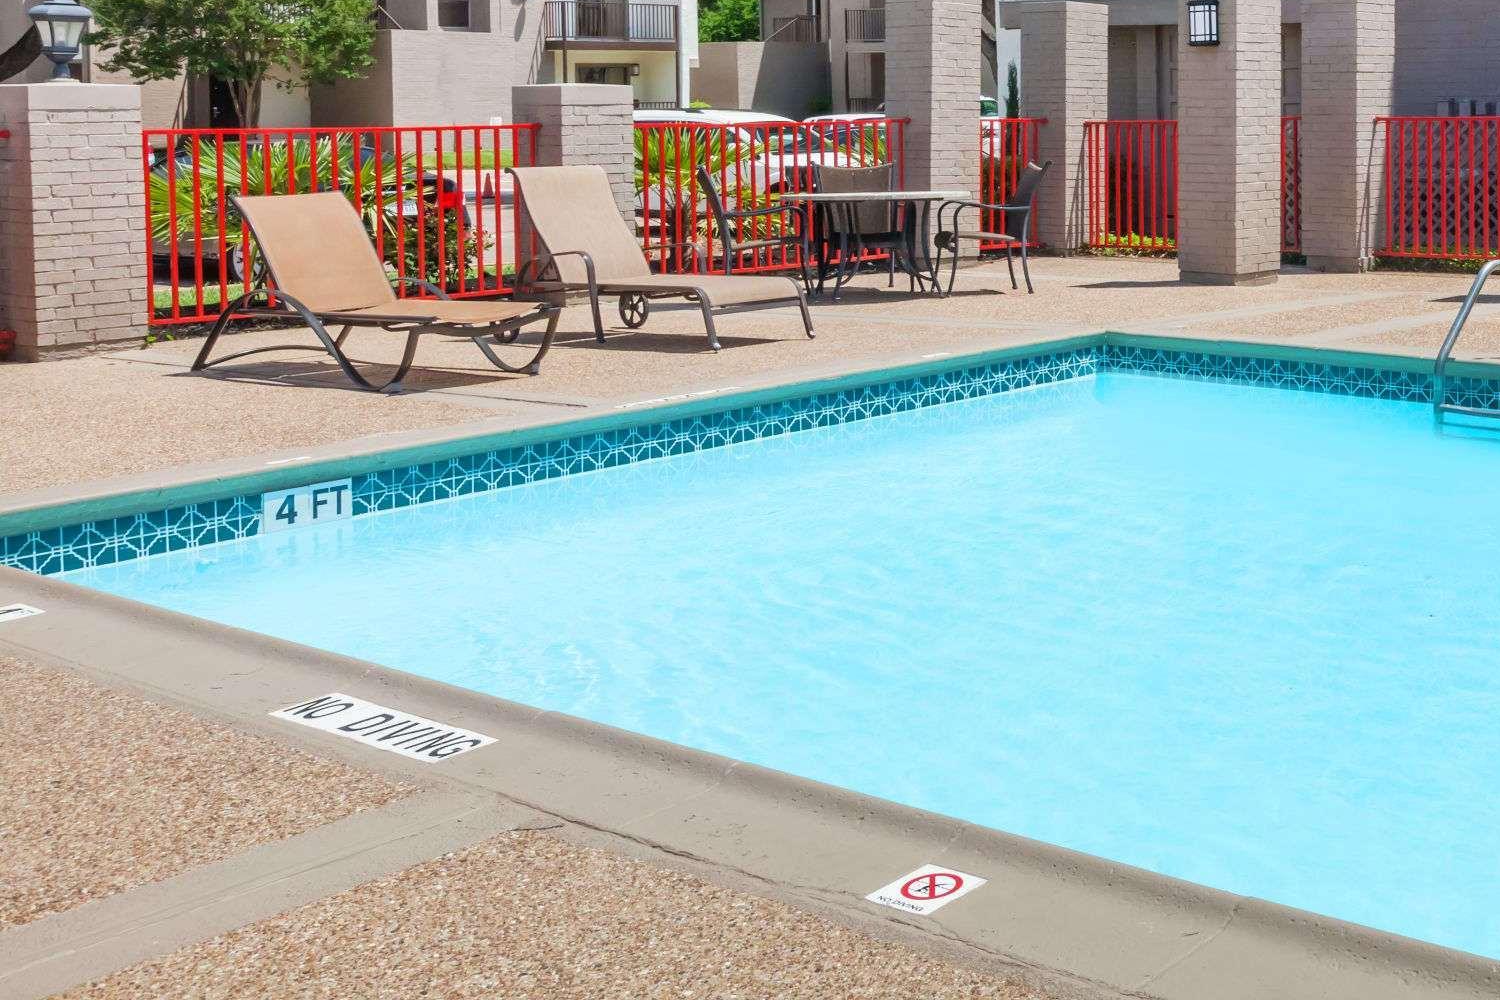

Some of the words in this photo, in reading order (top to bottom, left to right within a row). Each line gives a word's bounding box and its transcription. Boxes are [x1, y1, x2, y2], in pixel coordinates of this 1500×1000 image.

[276, 494, 297, 524] 4
[313, 484, 348, 519] FT
[283, 696, 354, 719] NO
[338, 713, 482, 759] DIVING
